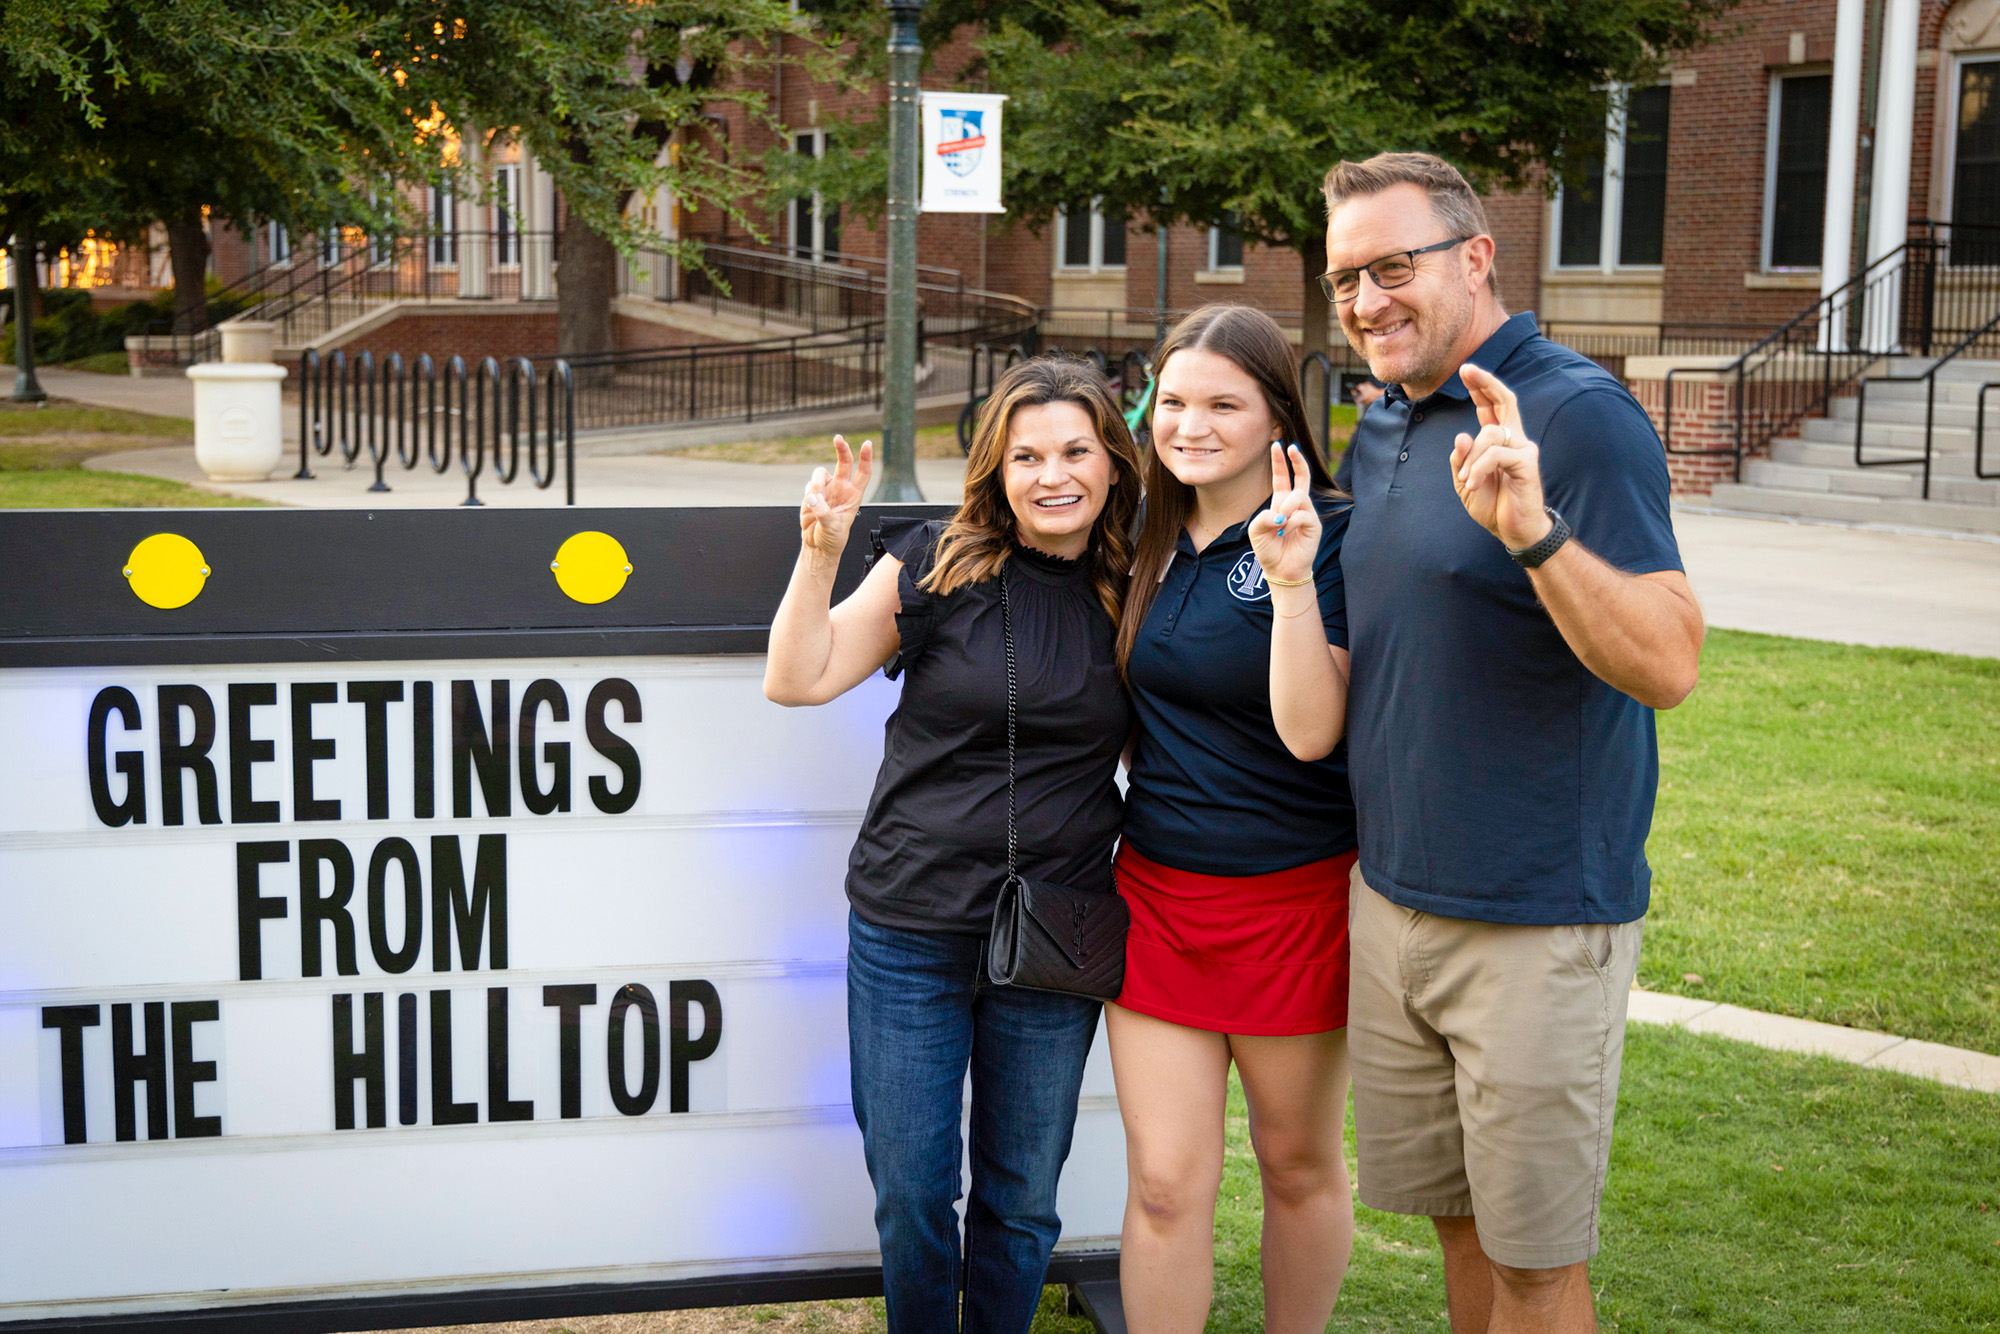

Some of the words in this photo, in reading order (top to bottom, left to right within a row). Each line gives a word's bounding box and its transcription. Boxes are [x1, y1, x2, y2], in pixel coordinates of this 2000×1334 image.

[88, 678, 642, 827] GREETINGS
[237, 834, 509, 981] FROM
[42, 1000, 222, 1144] THE
[333, 980, 722, 1130] HILLTOP
